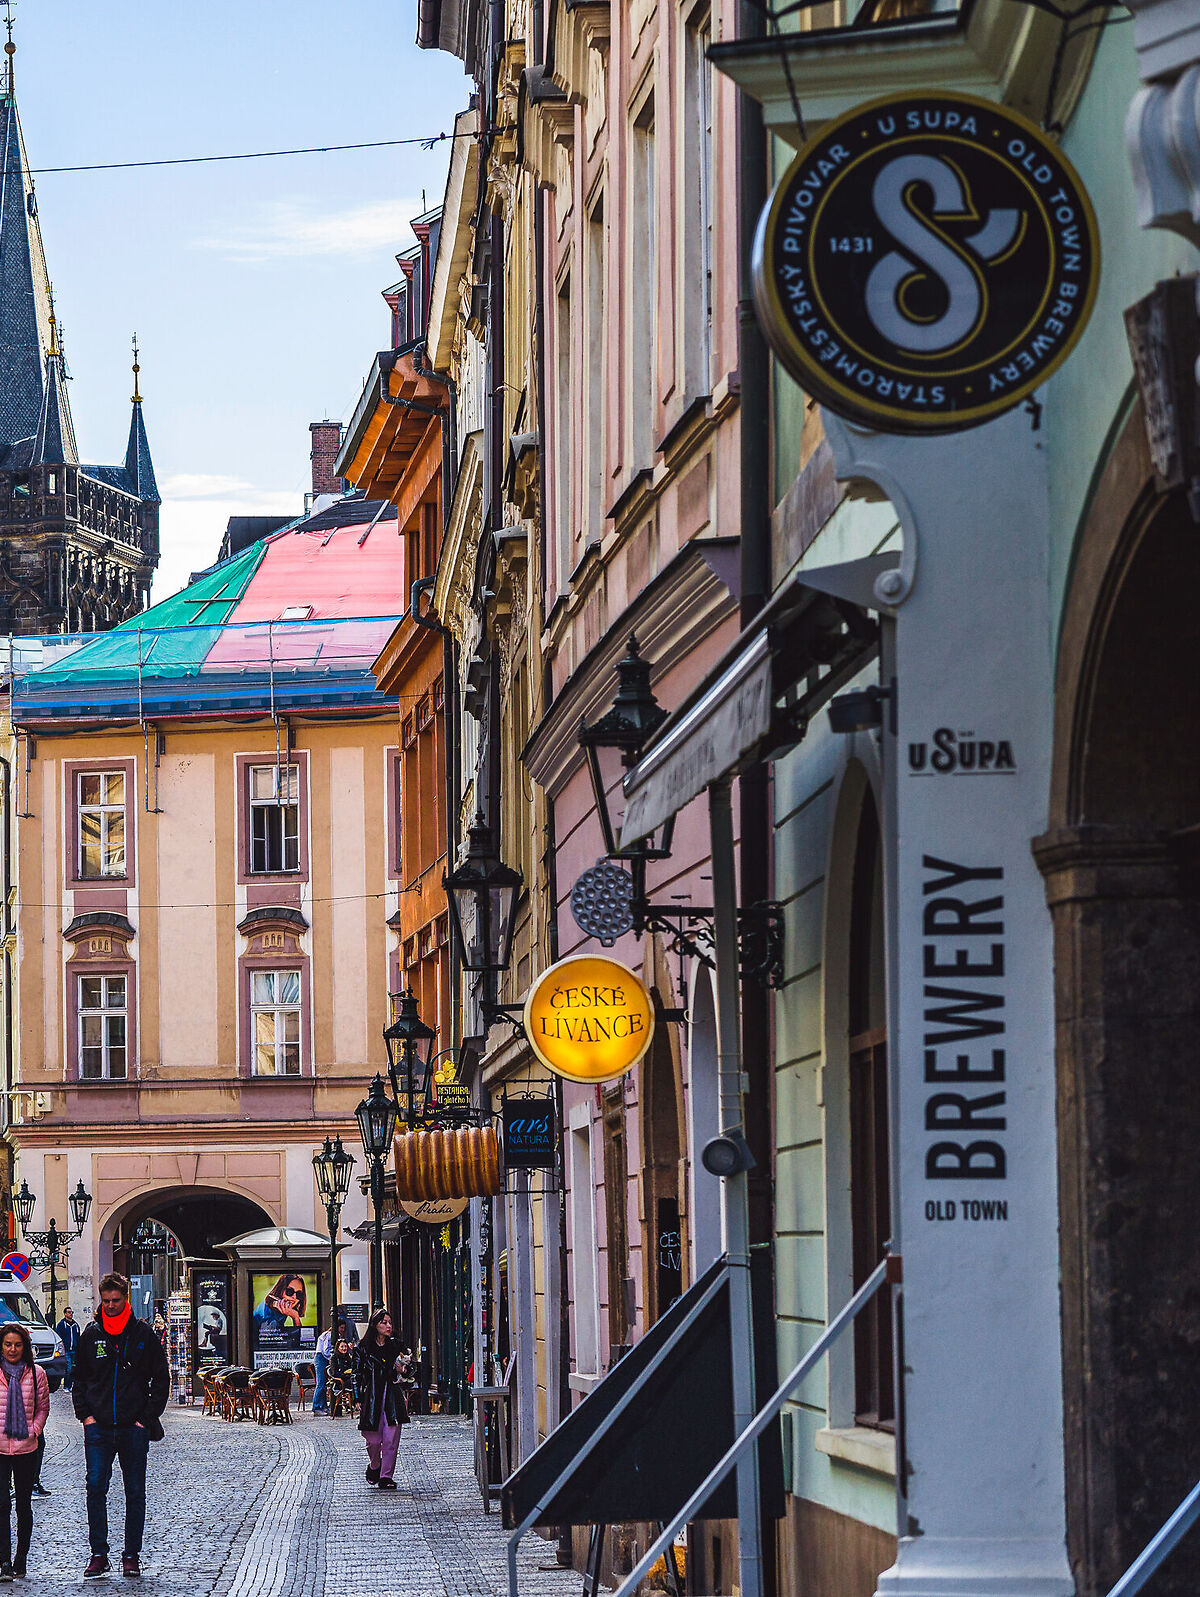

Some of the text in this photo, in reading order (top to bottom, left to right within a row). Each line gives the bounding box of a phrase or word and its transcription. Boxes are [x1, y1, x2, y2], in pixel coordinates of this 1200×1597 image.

[877, 111, 978, 135] U SUPA
[829, 236, 873, 253] 1431
[780, 143, 946, 404] STAROMĚSTSKÝ PIVOVAR
[987, 138, 1082, 392] OLD TOWN BREWERY
[550, 985, 626, 1008] ČESKÉ
[540, 1012, 643, 1042] LÍVANCE
[922, 854, 1007, 1180] BREWERY
[508, 1135, 549, 1144] NATURA
[415, 1201, 453, 1217] Praha
[925, 1200, 1008, 1221] OLD TOWN
